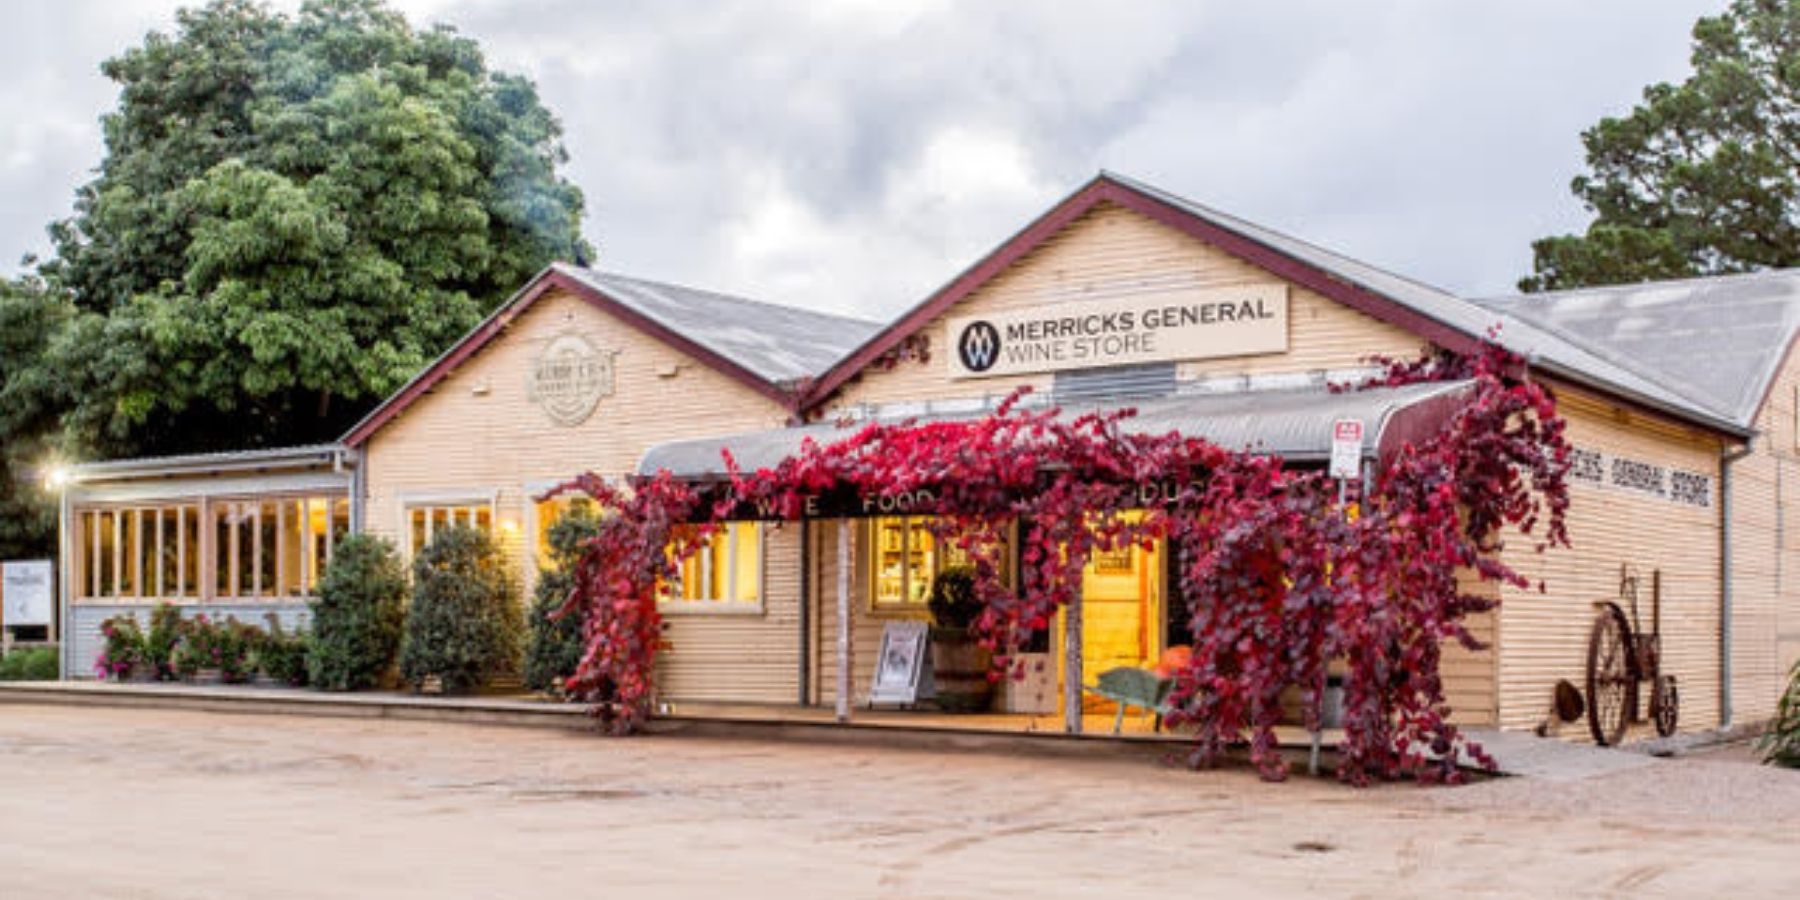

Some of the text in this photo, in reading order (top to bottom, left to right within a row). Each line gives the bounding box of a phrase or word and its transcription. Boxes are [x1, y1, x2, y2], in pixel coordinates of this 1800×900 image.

[1006, 298, 1274, 341] MERRICKS GENERAL
[1005, 332, 1156, 363] WINE STORE
